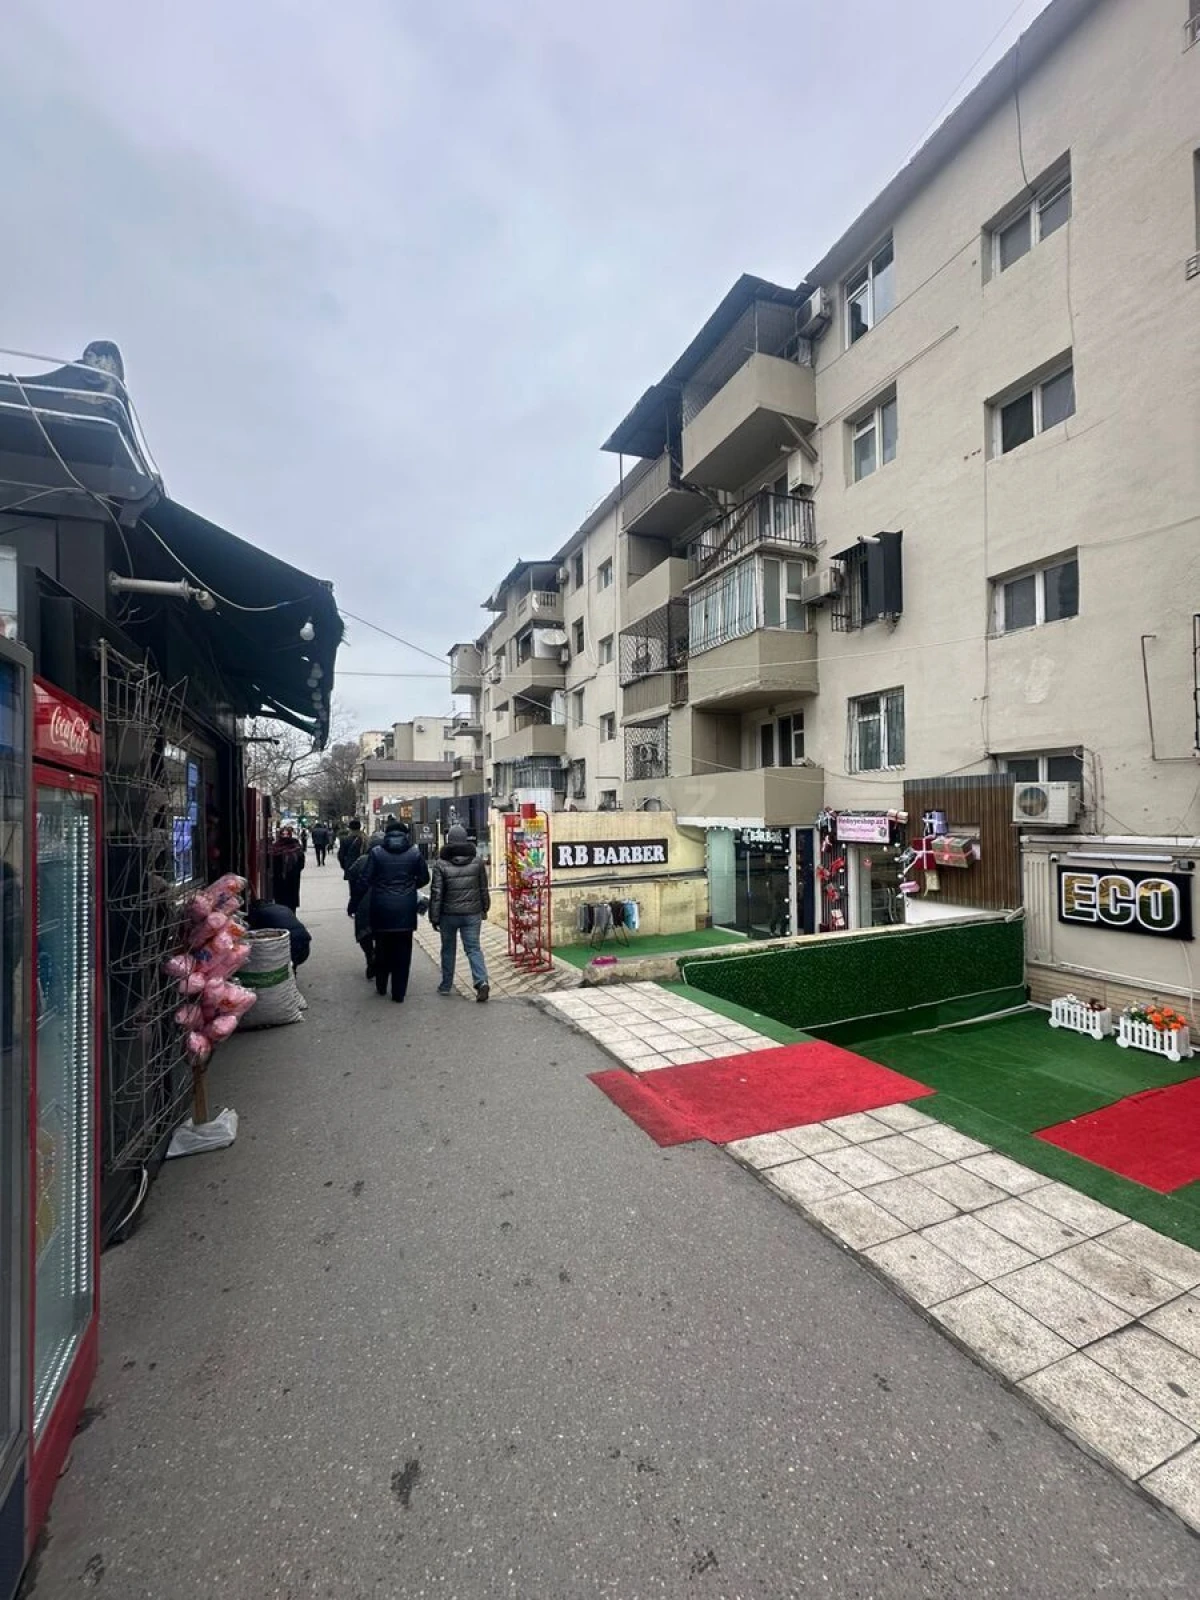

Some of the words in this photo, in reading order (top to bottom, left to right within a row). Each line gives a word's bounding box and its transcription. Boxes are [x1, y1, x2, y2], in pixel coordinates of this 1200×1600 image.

[558, 845, 589, 866] RB
[592, 845, 665, 865] BARBER
[1061, 872, 1180, 932] ECO
